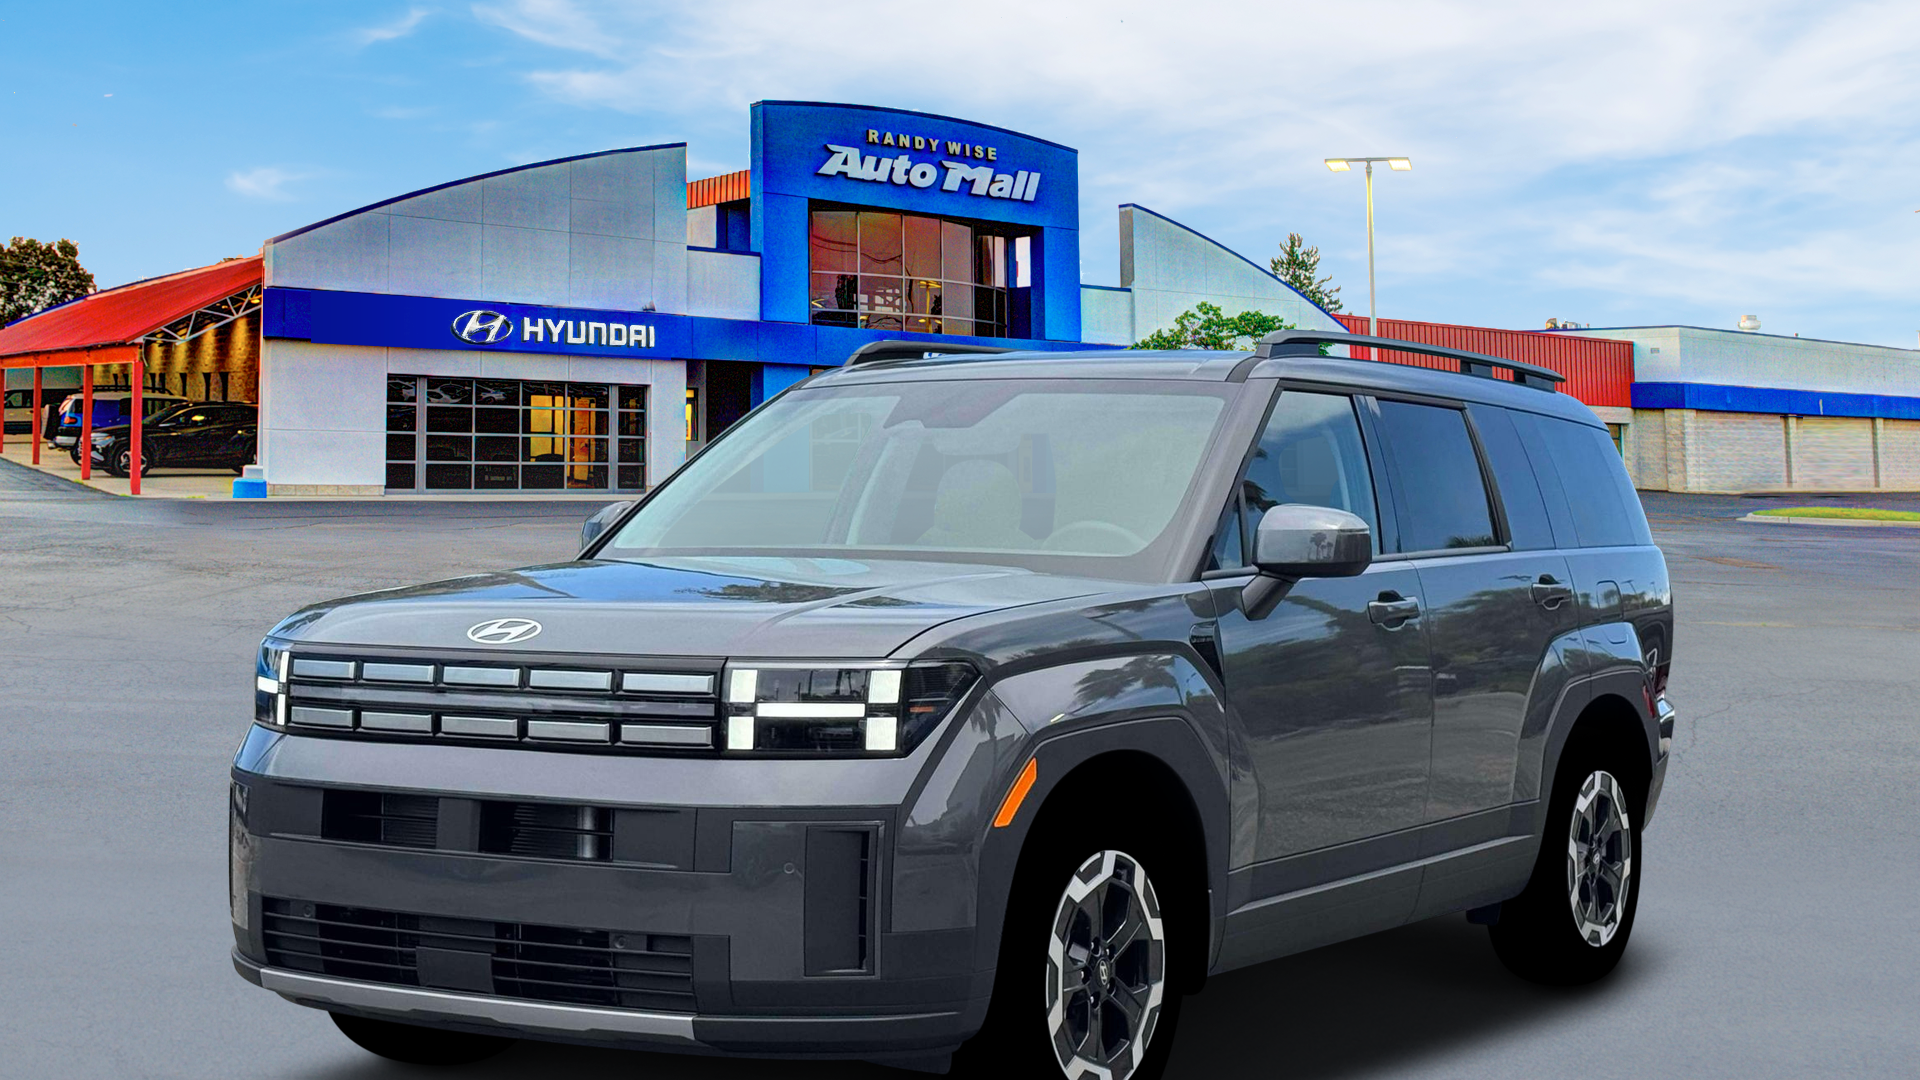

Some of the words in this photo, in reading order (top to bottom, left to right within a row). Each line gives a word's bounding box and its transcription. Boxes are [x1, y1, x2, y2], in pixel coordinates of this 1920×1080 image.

[867, 129, 939, 152] RANDY
[946, 140, 998, 161] WISE
[815, 143, 938, 188] Auto
[940, 160, 1041, 202] Mall
[522, 316, 656, 348] HYUNDAI
